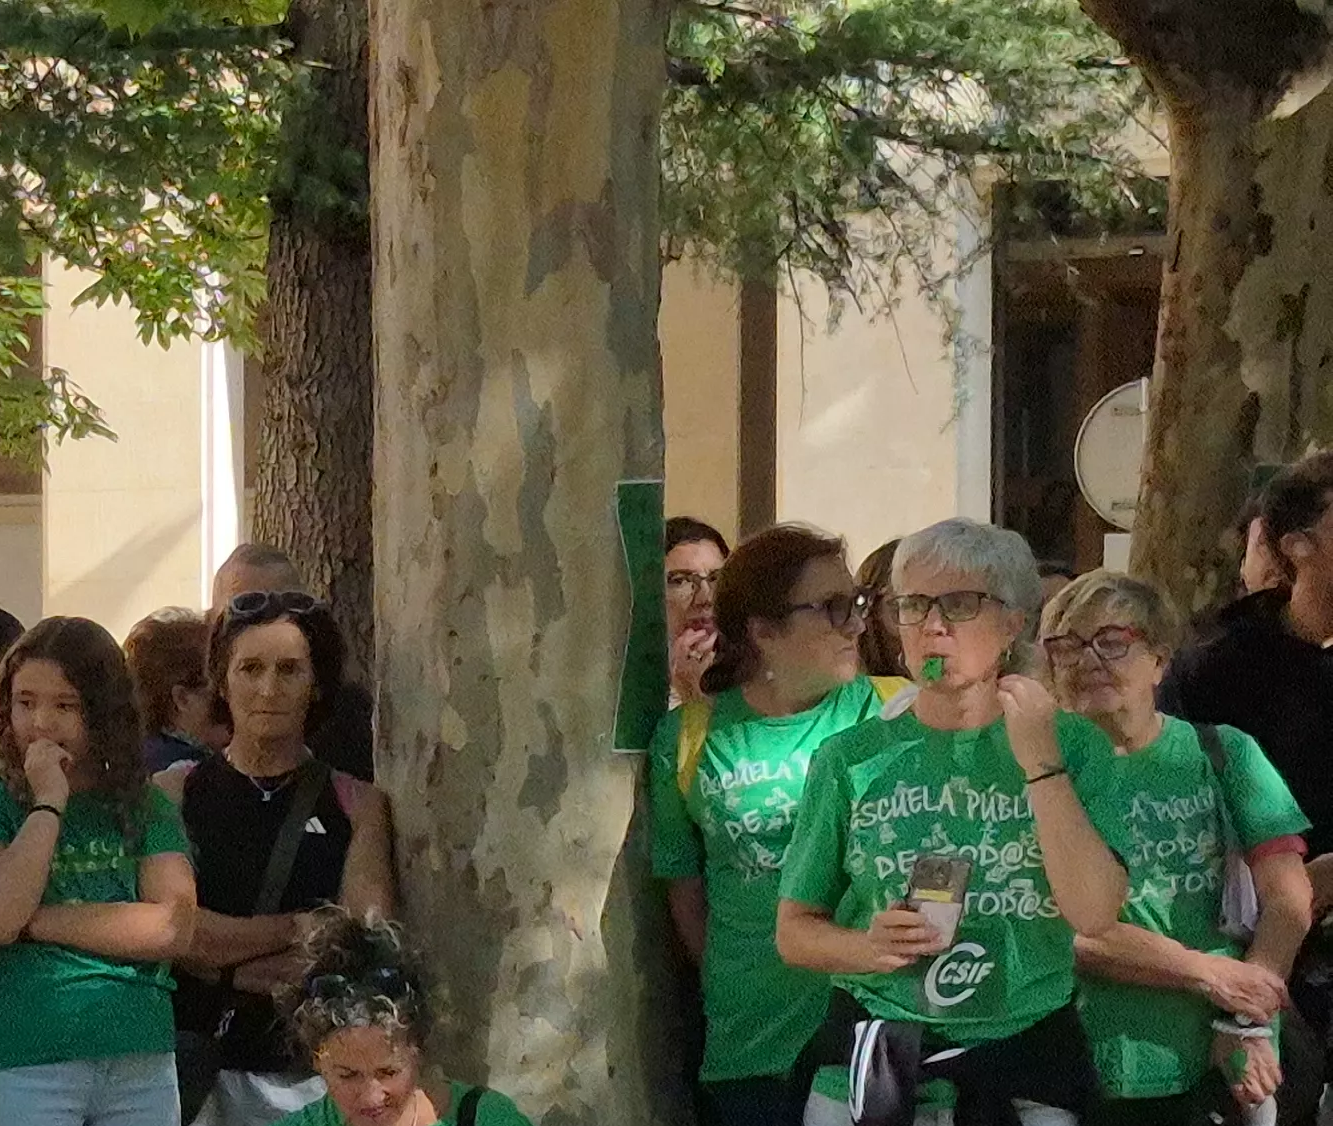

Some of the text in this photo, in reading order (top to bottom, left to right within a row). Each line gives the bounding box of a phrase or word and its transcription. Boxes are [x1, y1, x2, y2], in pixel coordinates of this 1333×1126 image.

[850, 783, 957, 830] ESCUELA
[874, 849, 918, 880] DE
[939, 961, 996, 985] CSIF
